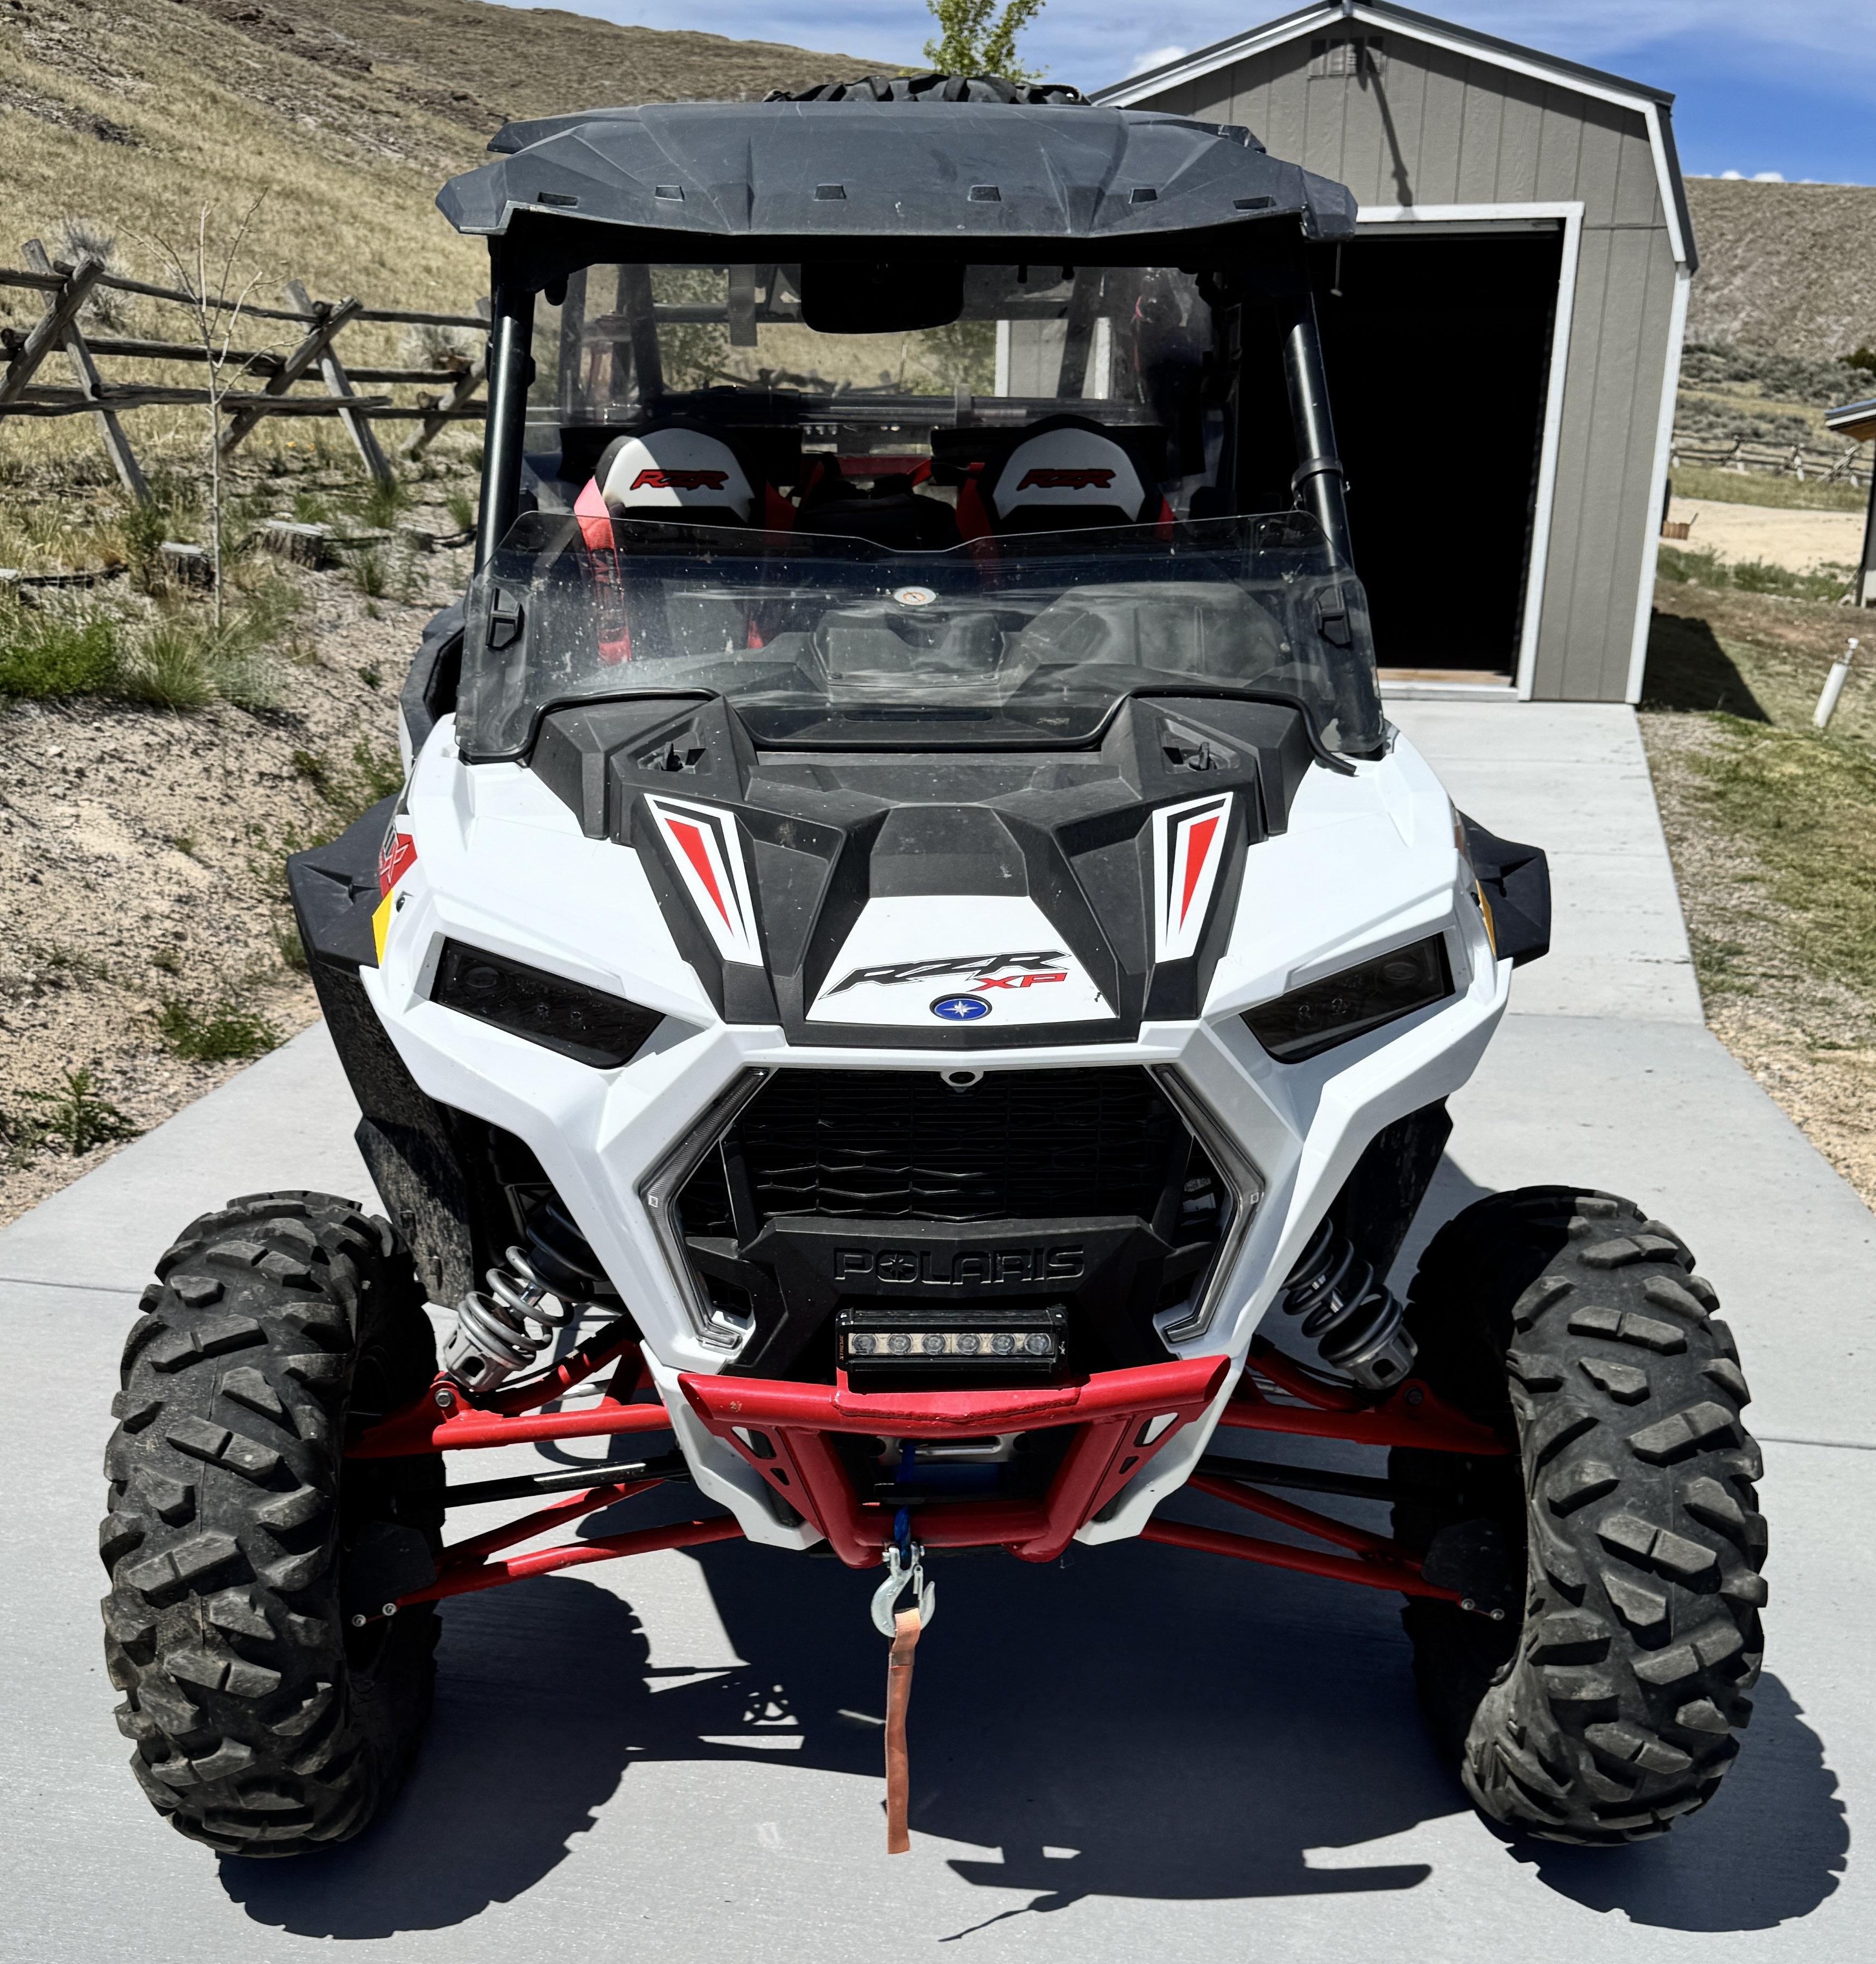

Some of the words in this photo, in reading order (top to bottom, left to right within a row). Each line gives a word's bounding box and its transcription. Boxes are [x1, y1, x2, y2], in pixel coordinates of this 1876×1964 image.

[630, 469, 729, 490] RZR
[1016, 469, 1116, 491] RZR
[818, 950, 1071, 1000] RZR
[967, 973, 1067, 992] XP
[834, 1244, 1085, 1285] POLARIS
